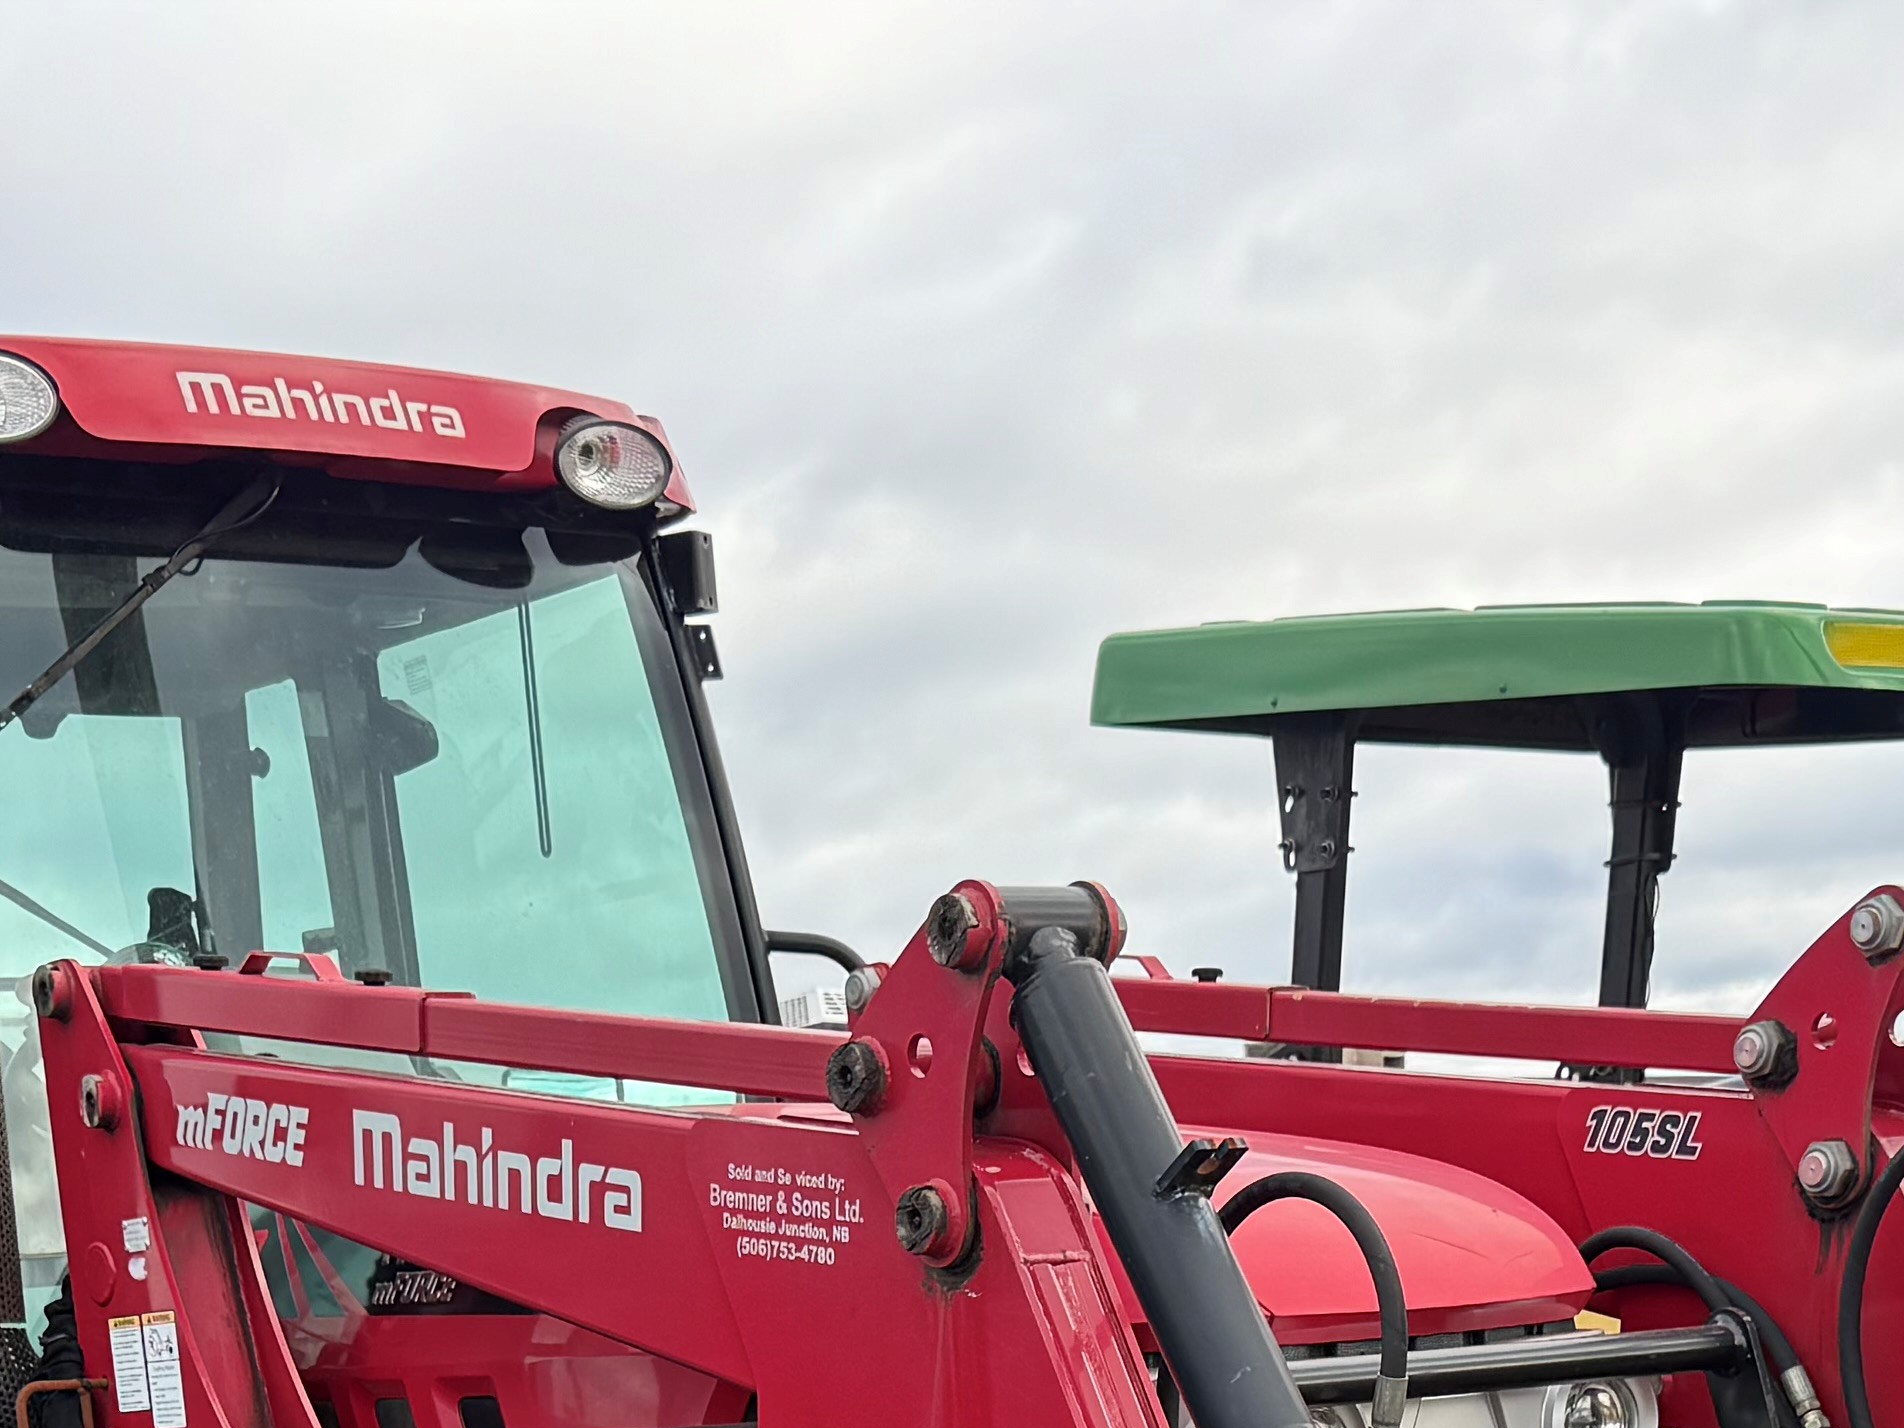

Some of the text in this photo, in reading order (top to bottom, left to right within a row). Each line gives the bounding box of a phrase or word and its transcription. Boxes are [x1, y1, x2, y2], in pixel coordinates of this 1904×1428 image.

[175, 371, 466, 439] Mahindra
[176, 1091, 310, 1168] mFORCE
[1583, 1104, 1703, 1161] 105SL
[352, 1108, 643, 1233] Mahindra
[728, 1163, 752, 1181] Sold
[755, 1168, 775, 1184] and
[709, 1183, 864, 1224] Bremner & Sons Ltd.
[723, 1212, 850, 1244] Dalhousie Junction, NB
[737, 1236, 835, 1266] (506)753-4780
